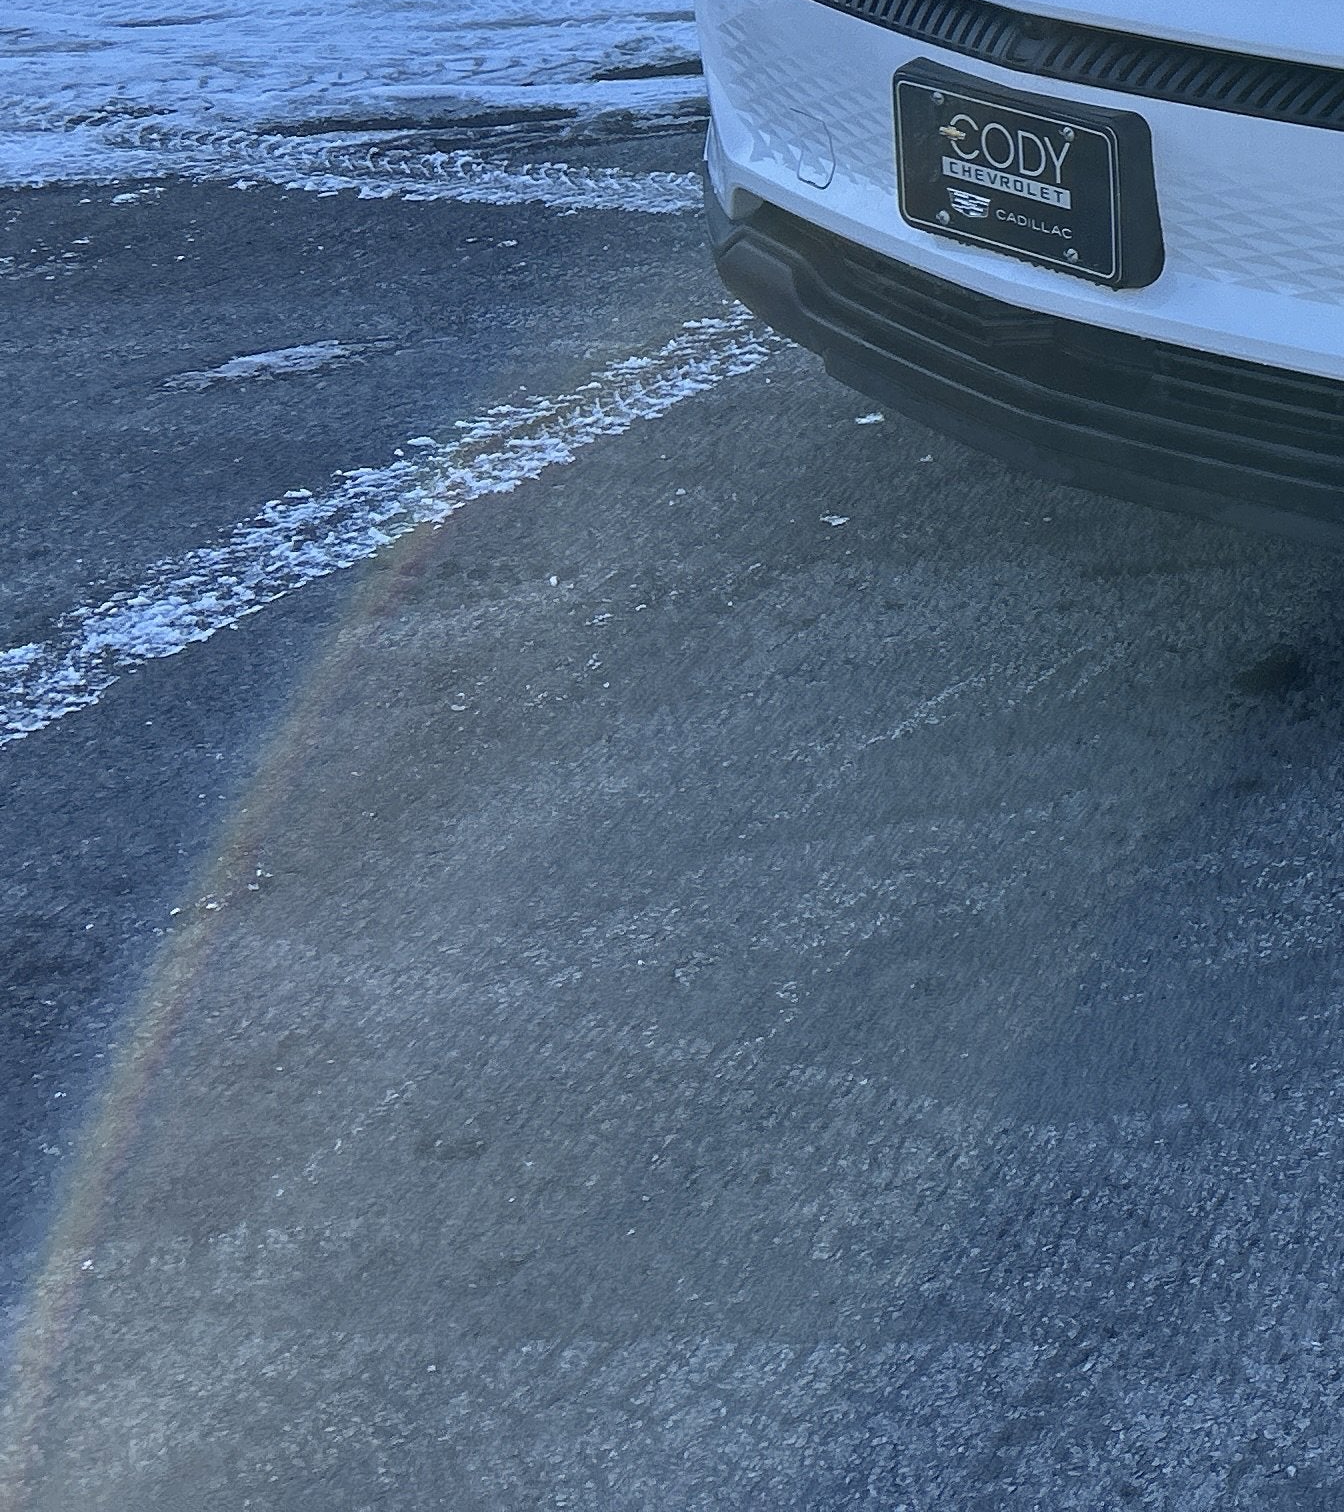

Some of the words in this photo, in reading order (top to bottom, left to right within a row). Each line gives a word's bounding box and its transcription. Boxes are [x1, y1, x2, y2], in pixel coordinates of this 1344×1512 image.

[949, 113, 1071, 185] CODY
[948, 160, 1065, 205] CHEVROLET
[995, 208, 1073, 240] CADILLAC
